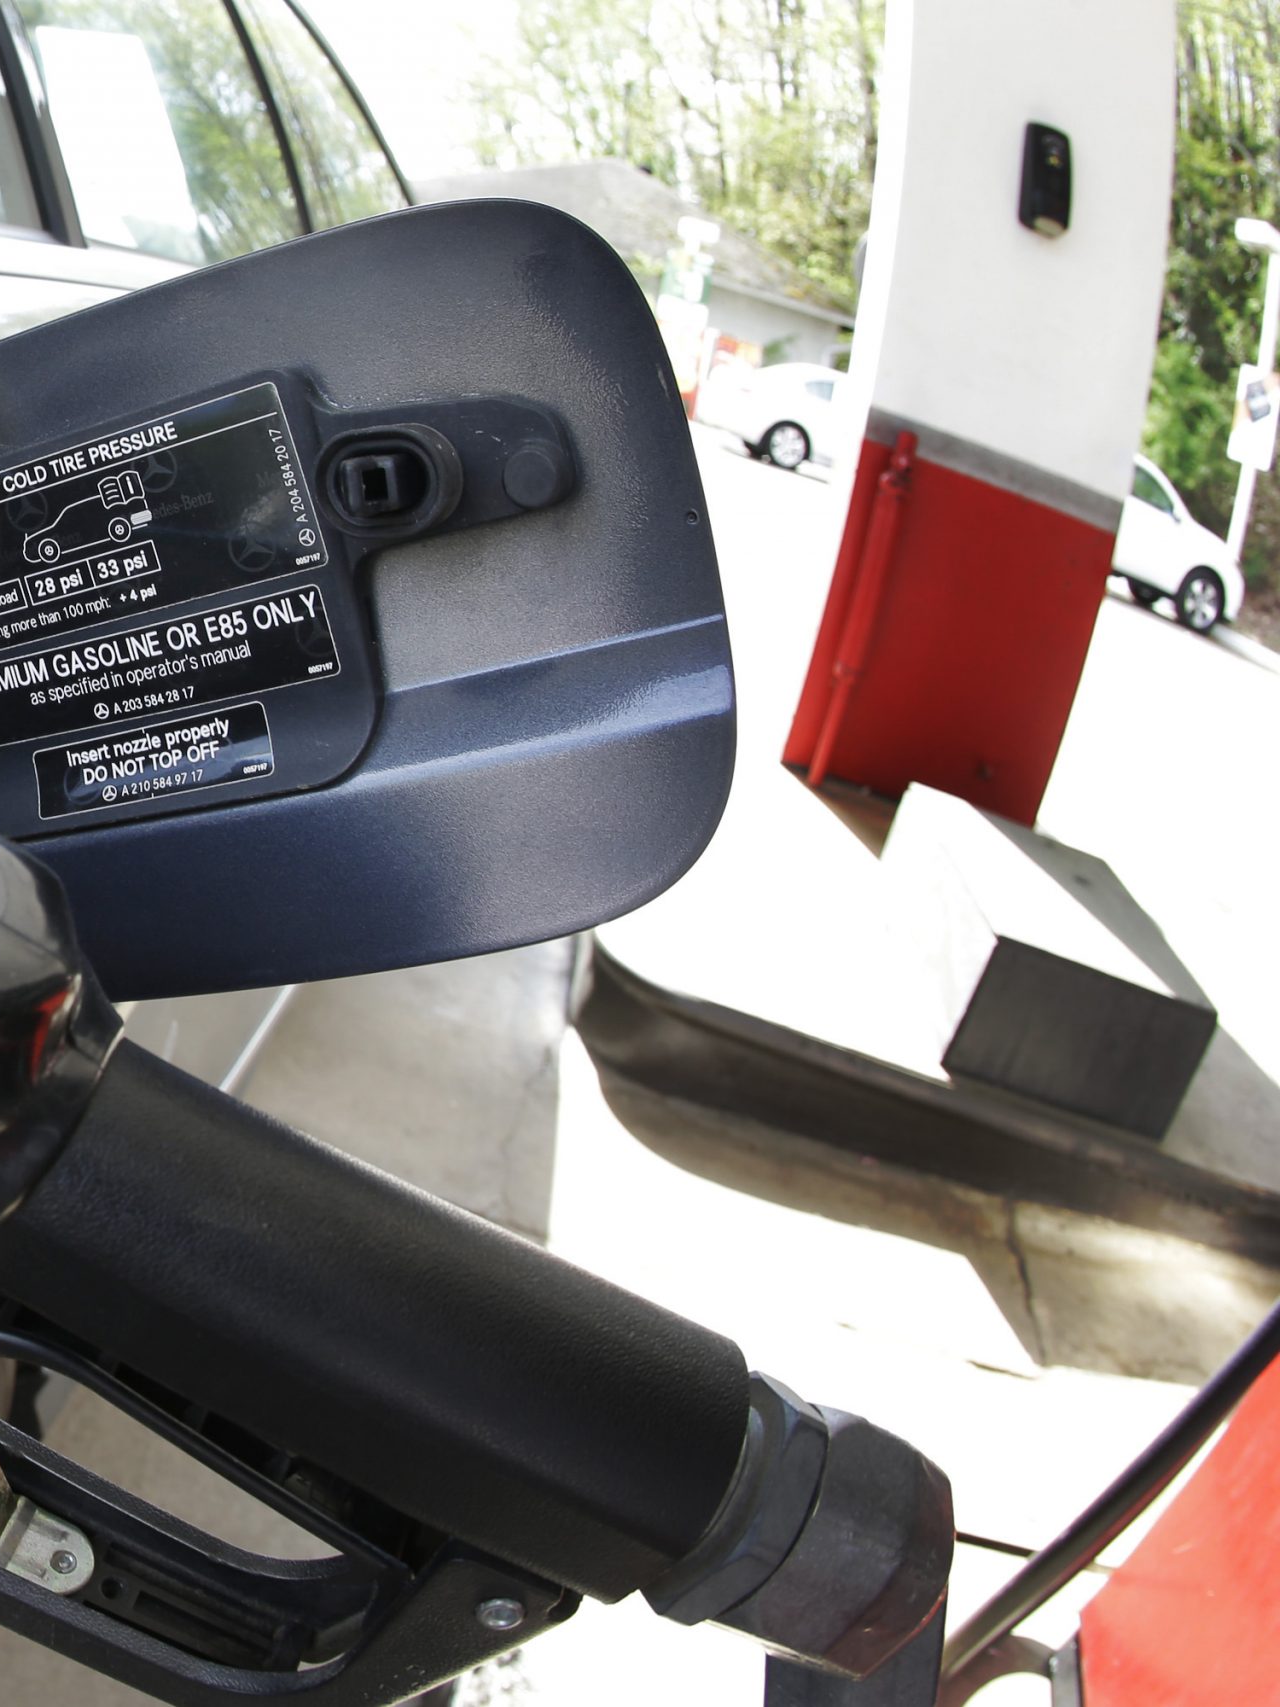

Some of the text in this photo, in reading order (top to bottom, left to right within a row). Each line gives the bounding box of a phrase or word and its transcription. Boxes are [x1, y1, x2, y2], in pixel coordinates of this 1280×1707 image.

[2, 421, 178, 492] COLD TIRE PRESSURE
[268, 429, 309, 522] A 204 584 20 17
[34, 550, 148, 597] 28 psi 33 psi
[11, 617, 37, 634] more
[38, 608, 62, 627] than
[63, 602, 84, 619] 100
[85, 597, 111, 616] mph:
[119, 593, 127, 603] +
[130, 589, 138, 601] 4
[139, 583, 158, 602] psi
[52, 631, 163, 677] GASOLINE
[166, 622, 201, 651] OR
[203, 610, 248, 644] E85
[252, 591, 316, 630] ONLY
[30, 640, 252, 706] as specified in operator's manual
[114, 686, 195, 715] A 203 584 28 17
[66, 717, 230, 767] Insert nozzle properly
[82, 740, 220, 786] DO NOT TOP OFF
[121, 769, 204, 797] A 210 584 97 17
